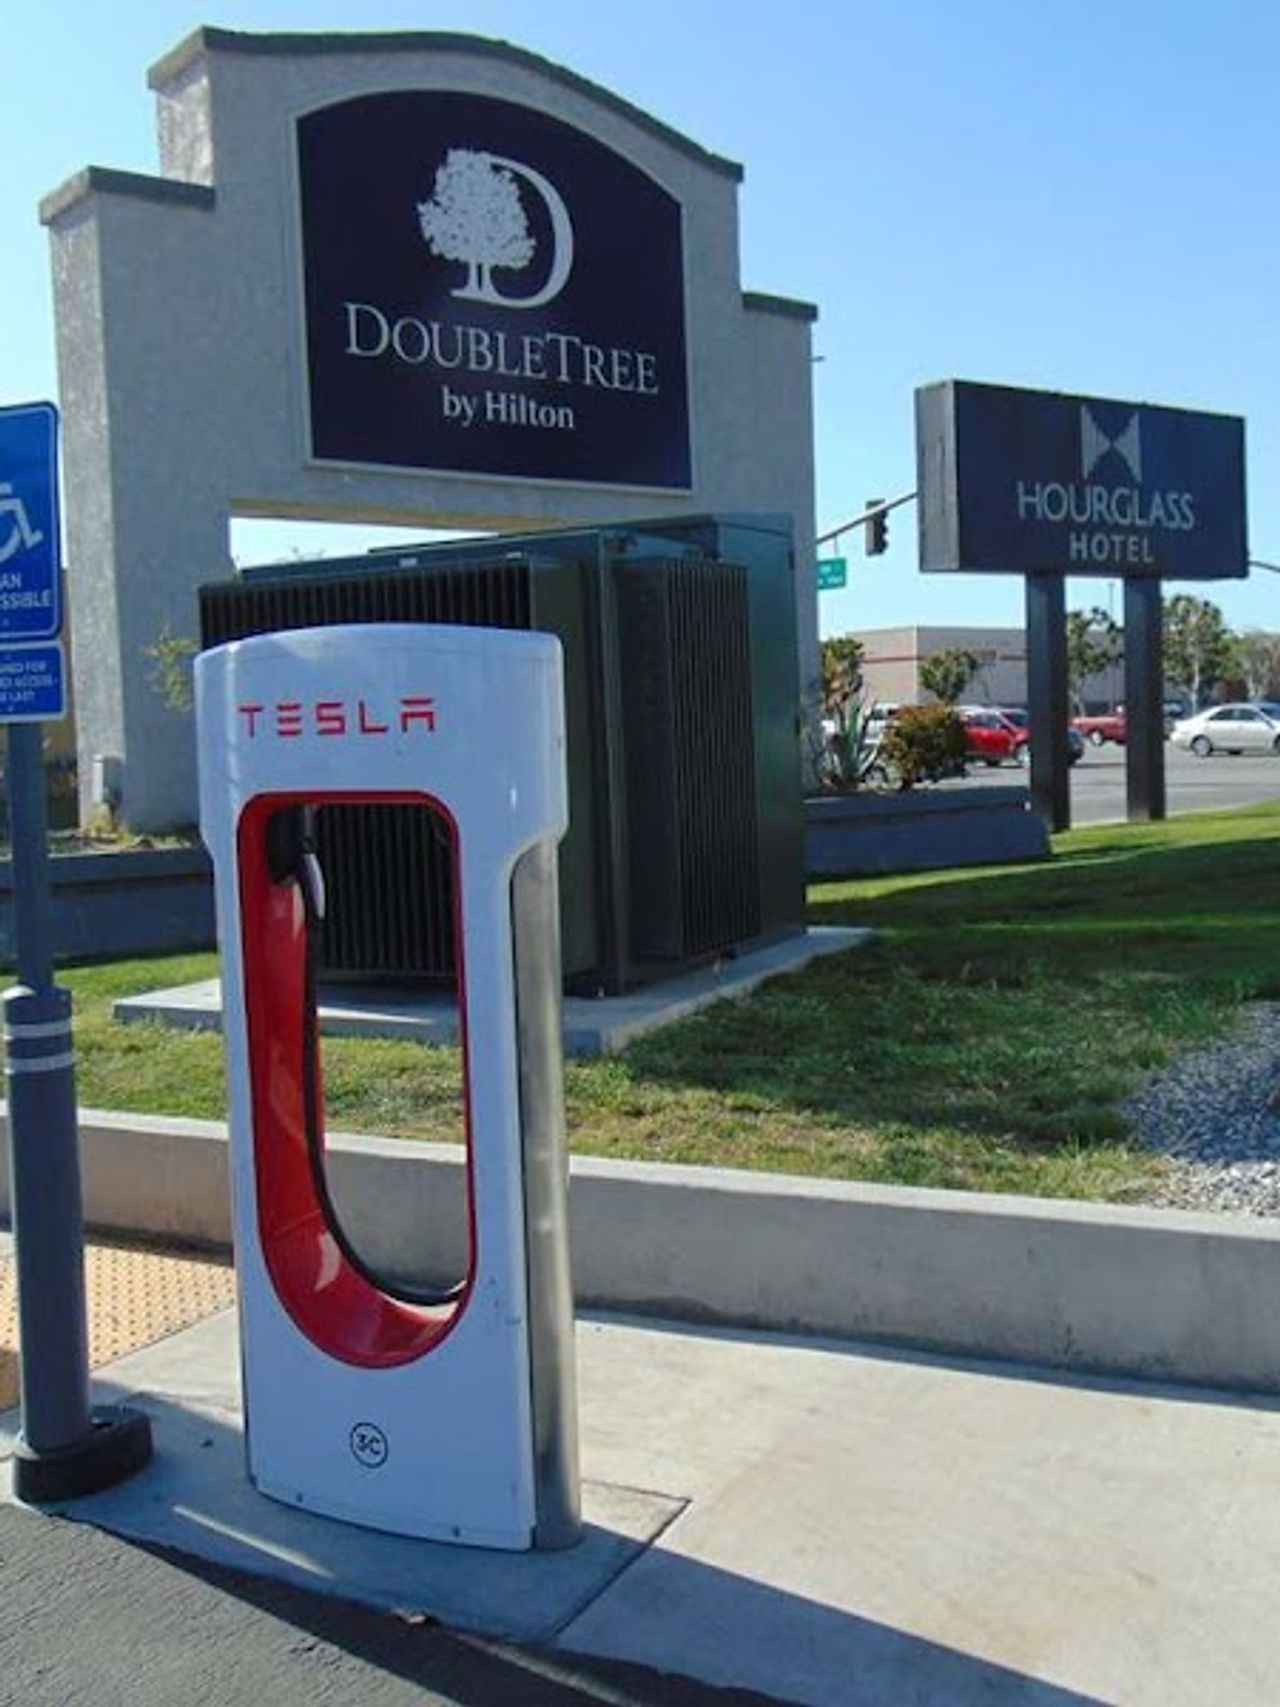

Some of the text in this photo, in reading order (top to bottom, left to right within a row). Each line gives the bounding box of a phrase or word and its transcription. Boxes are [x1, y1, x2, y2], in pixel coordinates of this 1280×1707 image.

[442, 386, 575, 430] by Hilton
[1017, 480, 1196, 531] HOURGLASS
[1069, 531, 1155, 564] HOTEL
[237, 698, 435, 738] TESLA
